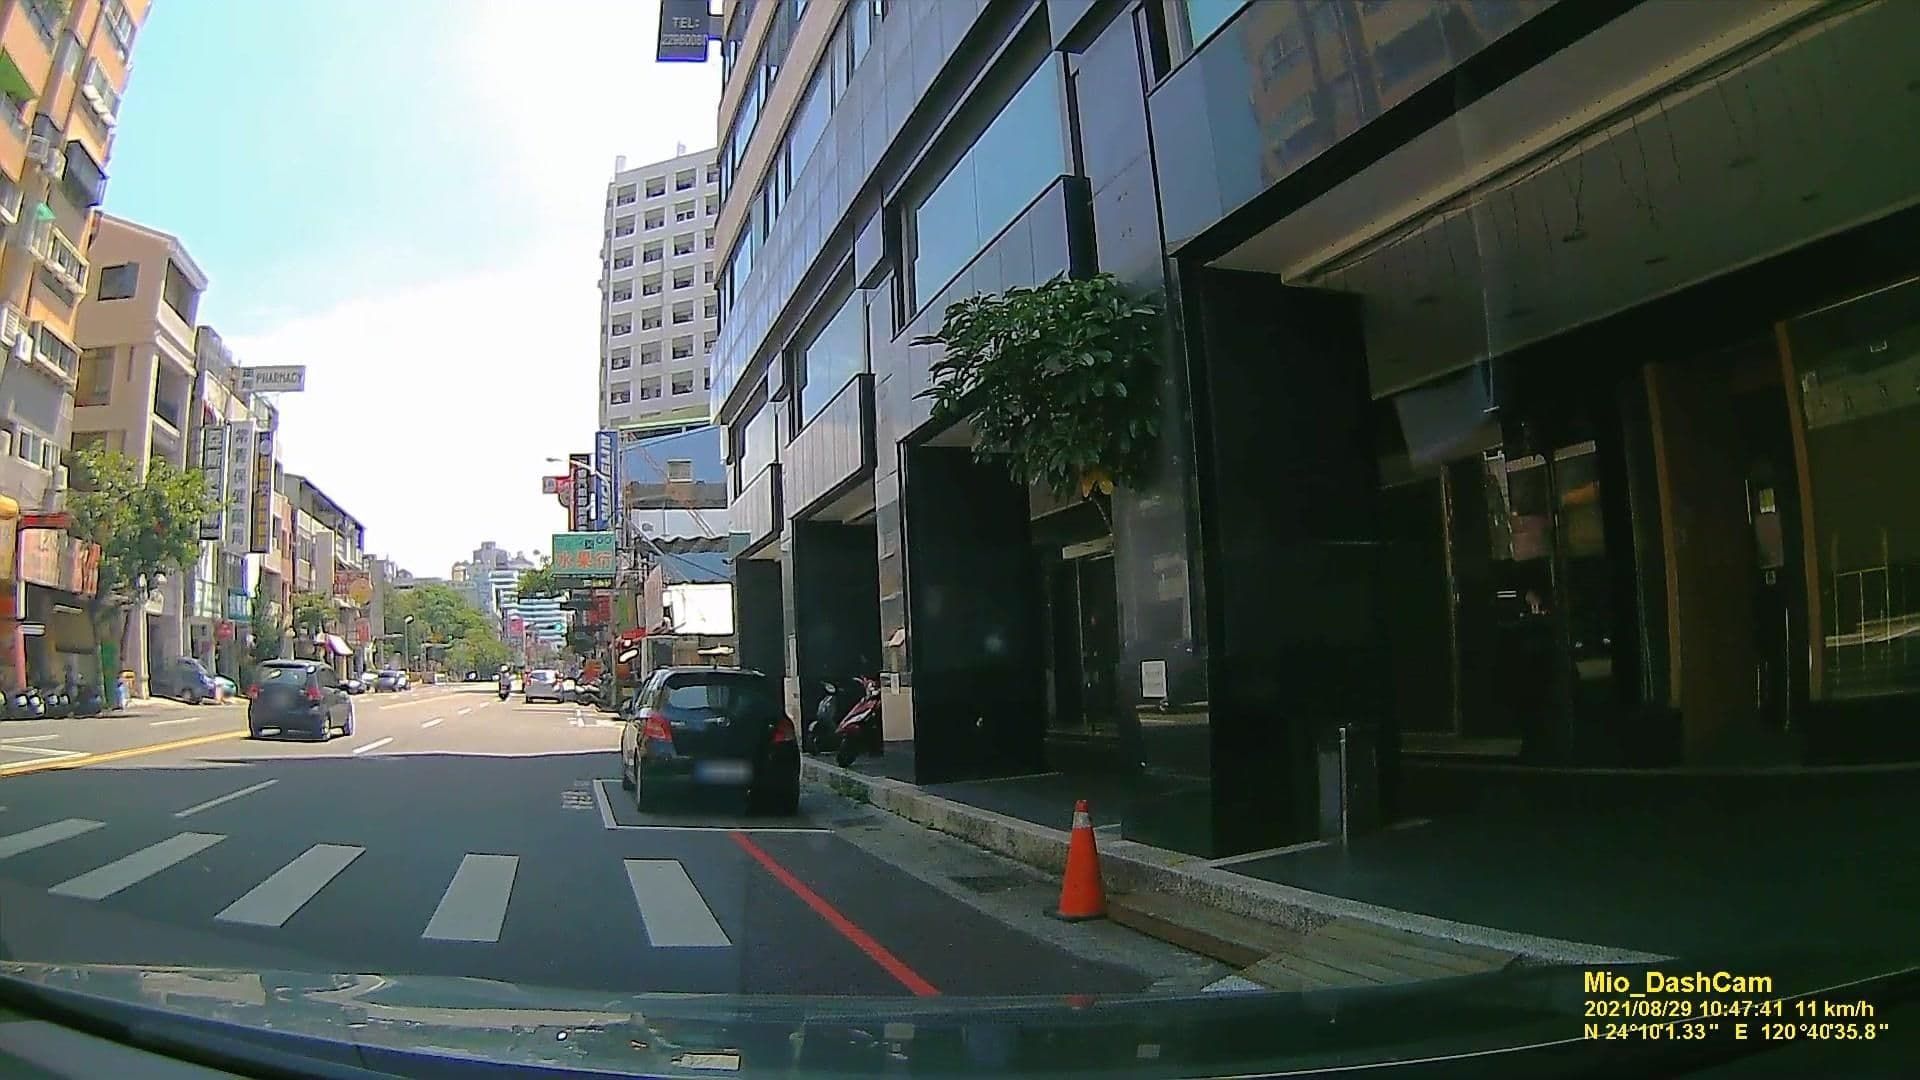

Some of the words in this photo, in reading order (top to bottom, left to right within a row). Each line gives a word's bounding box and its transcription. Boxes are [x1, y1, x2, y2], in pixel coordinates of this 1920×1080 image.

[672, 16, 700, 29] TEL:
[256, 371, 304, 384] PHARMACY
[600, 433, 612, 521] MICHELIN
